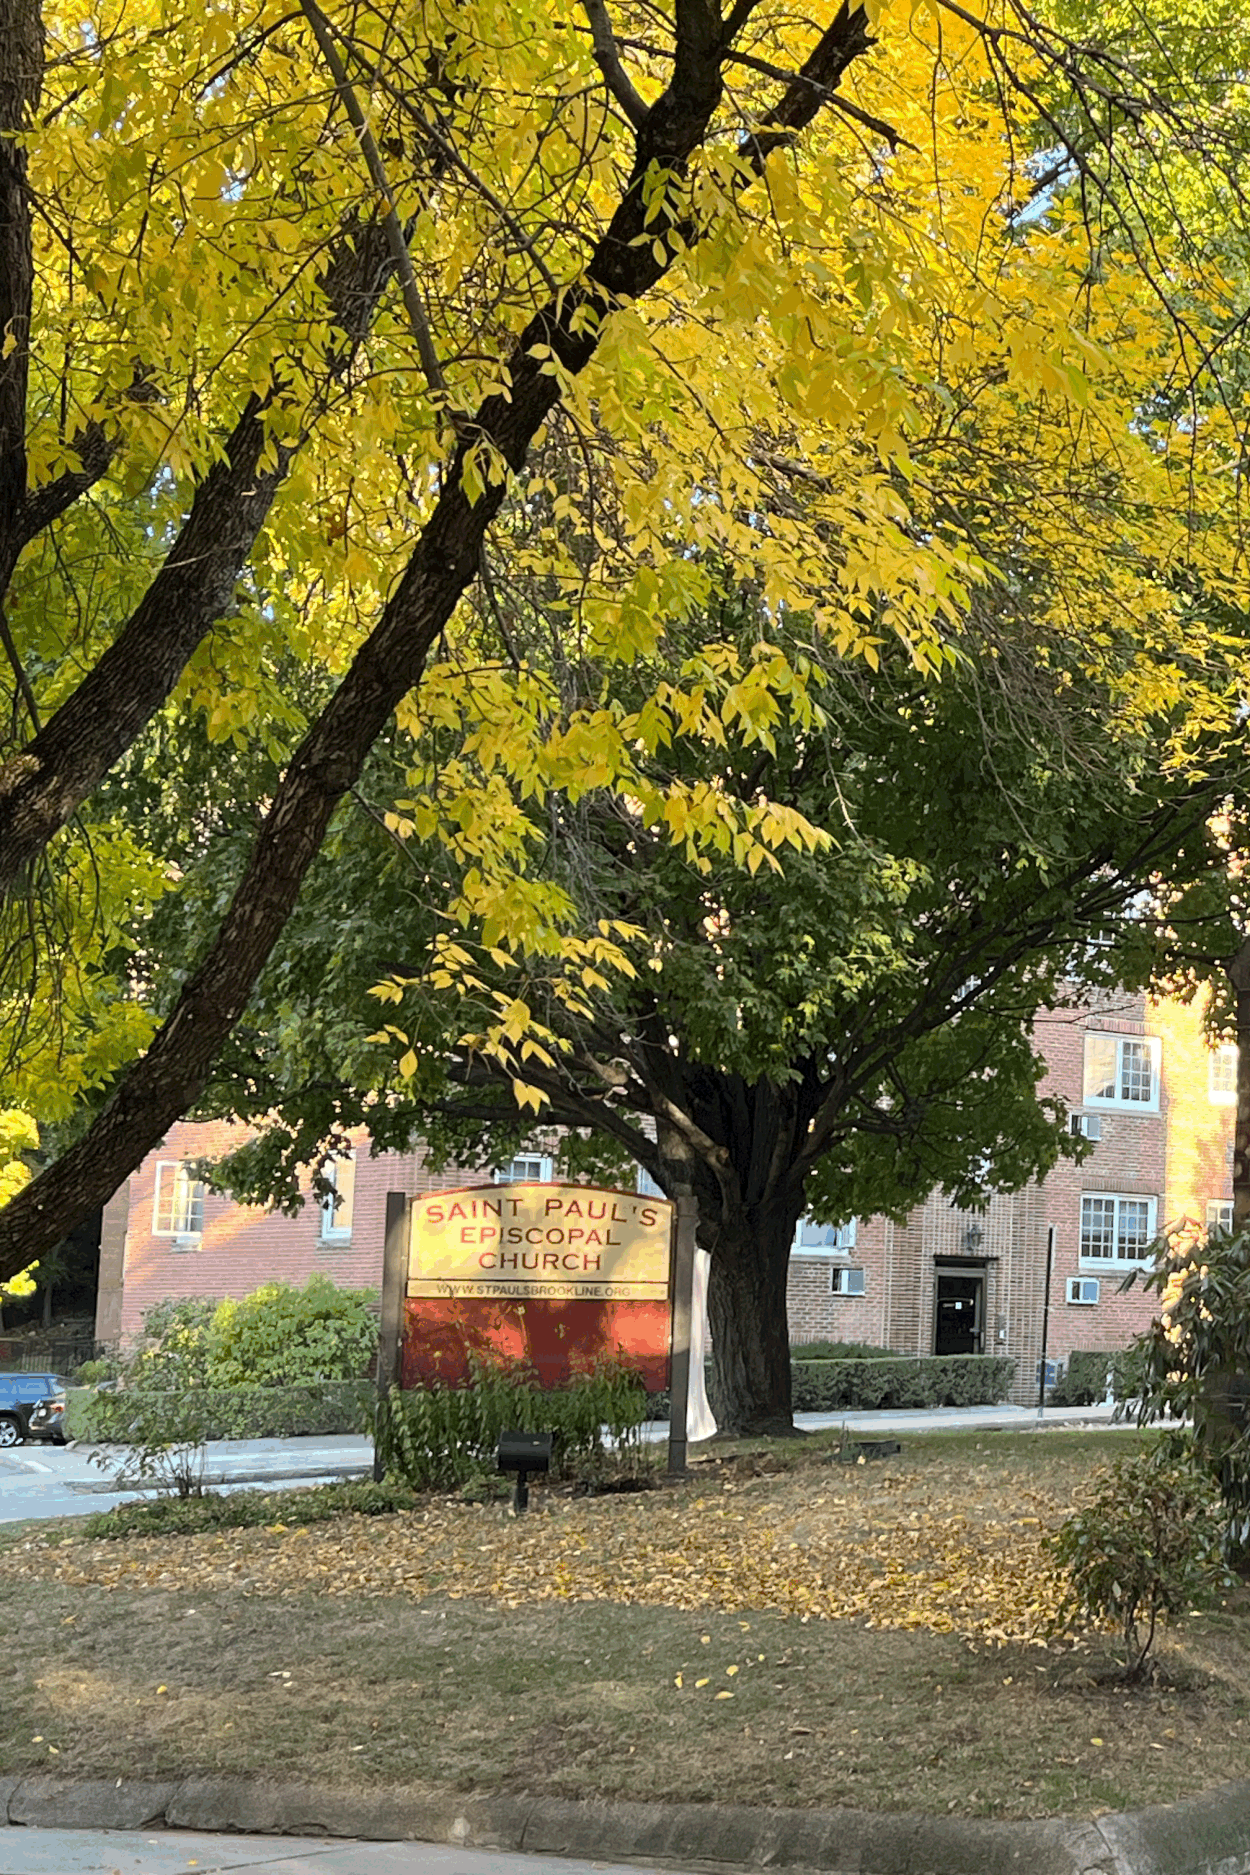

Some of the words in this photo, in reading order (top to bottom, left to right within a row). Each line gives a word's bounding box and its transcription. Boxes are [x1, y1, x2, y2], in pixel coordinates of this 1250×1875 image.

[426, 1198, 523, 1224] SAINT
[545, 1198, 657, 1227] PAUL'S
[460, 1227, 621, 1246] EPISCOPAL
[478, 1252, 601, 1270] CHURCH
[436, 1284, 631, 1297] WWW.STPAULSBROOKLINE.ORG
